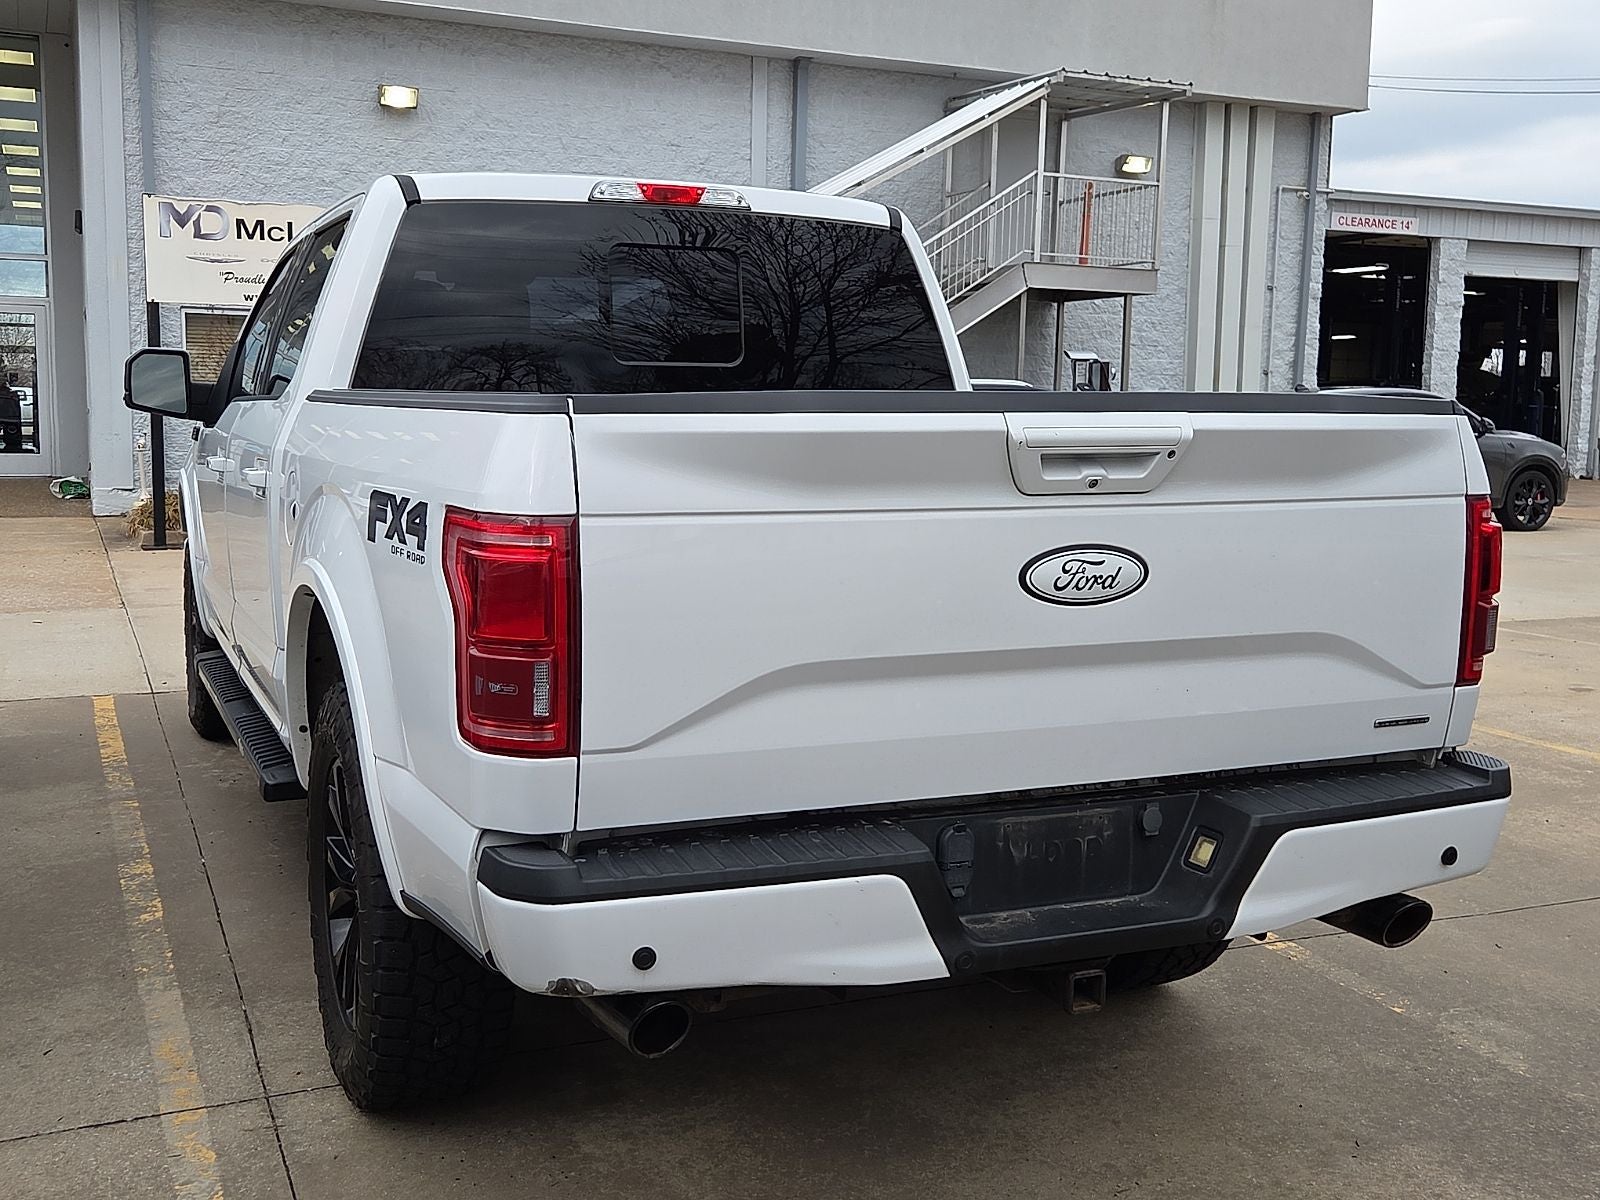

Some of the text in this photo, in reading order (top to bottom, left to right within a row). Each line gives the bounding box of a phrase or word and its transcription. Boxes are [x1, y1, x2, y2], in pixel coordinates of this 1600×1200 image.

[1338, 215, 1398, 229] CLEARANCE
[367, 489, 429, 552] FX4
[391, 544, 426, 565] OFF ROAD
[1053, 558, 1122, 592] Ford
